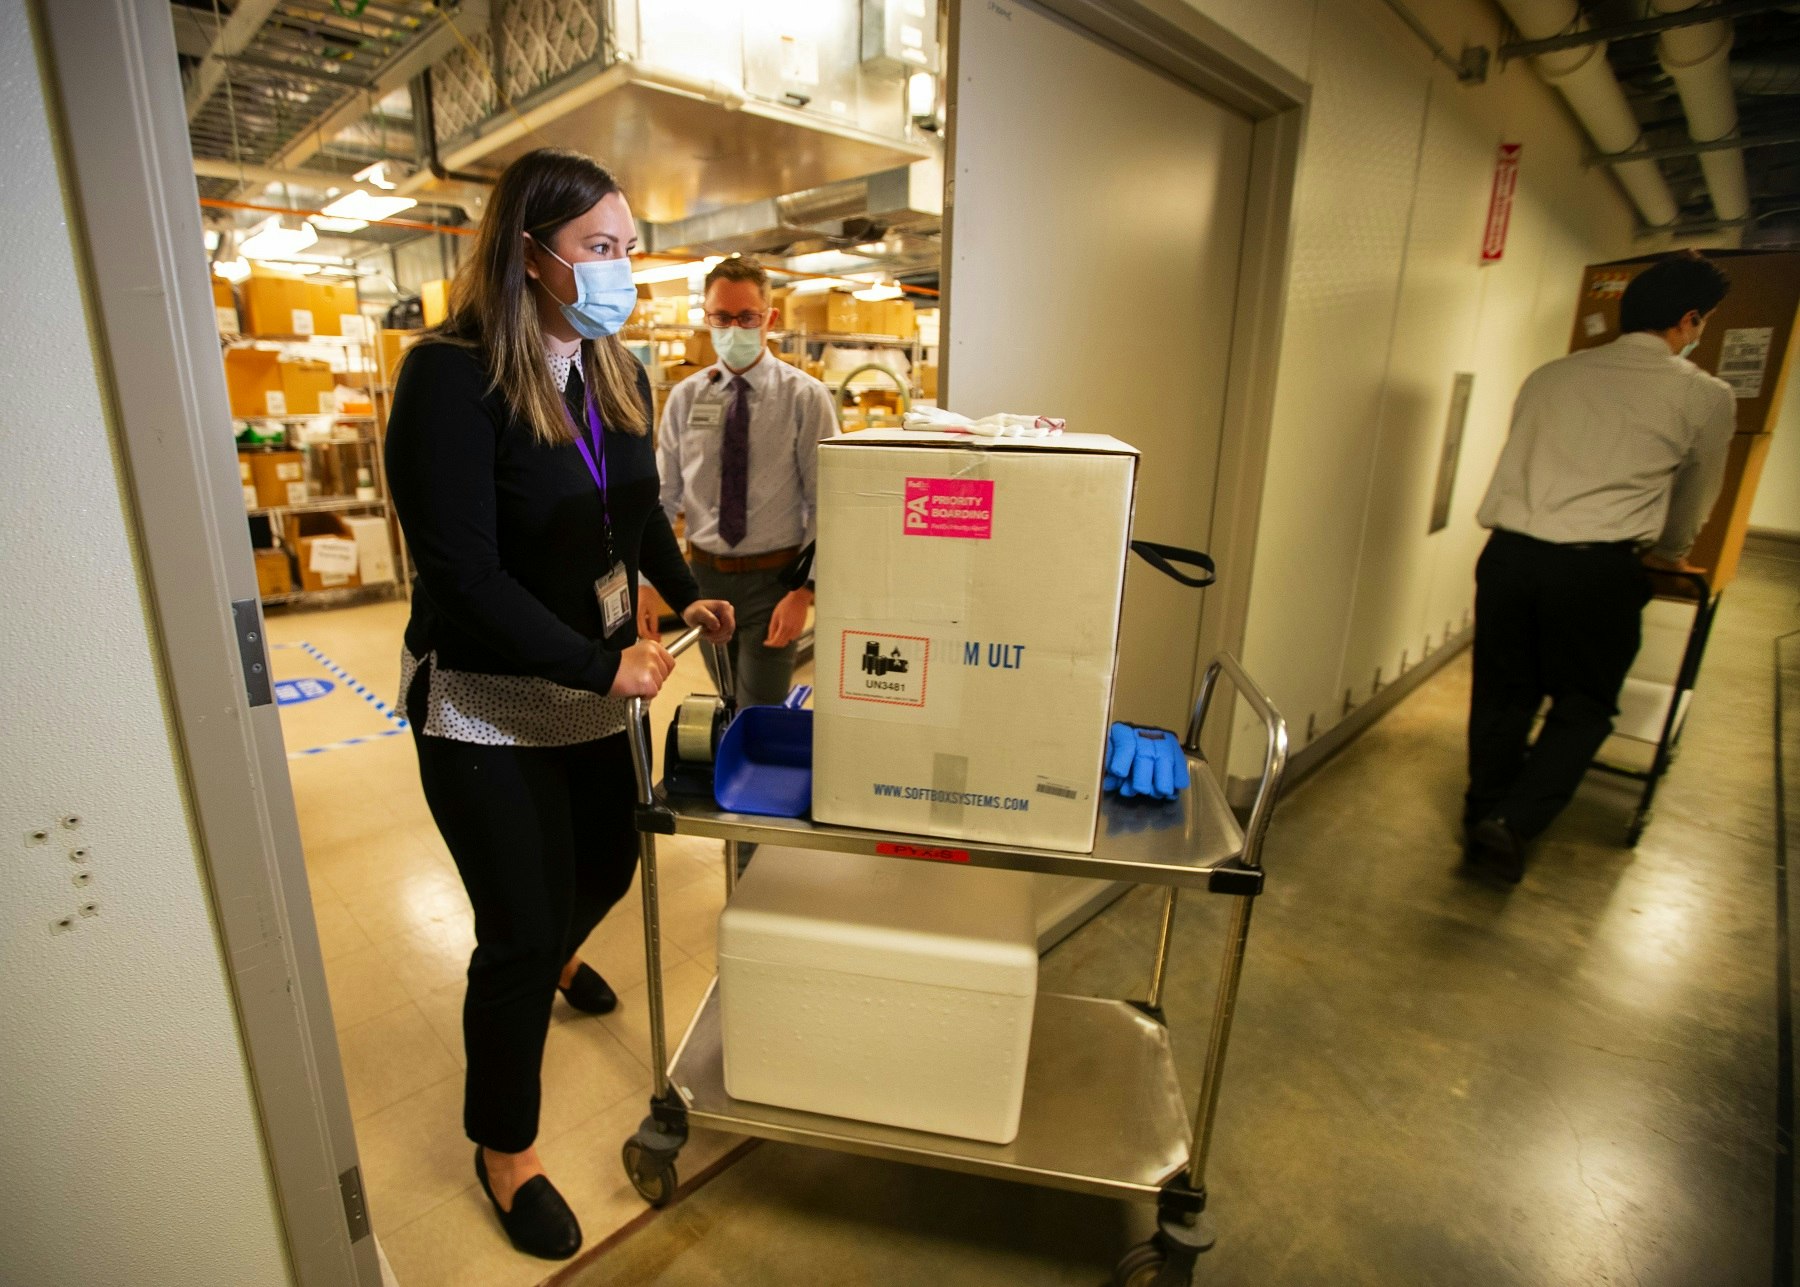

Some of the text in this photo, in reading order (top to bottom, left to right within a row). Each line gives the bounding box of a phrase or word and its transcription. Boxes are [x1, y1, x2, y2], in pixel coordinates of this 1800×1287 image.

[931, 495, 984, 507] PRIORITY
[906, 495, 930, 529] PA
[931, 508, 990, 520] BOARDING
[988, 643, 1026, 669] ULT
[866, 680, 906, 692] UN3481
[873, 783, 1030, 811] WWW.SOFTBOXSYSTEMS.COM
